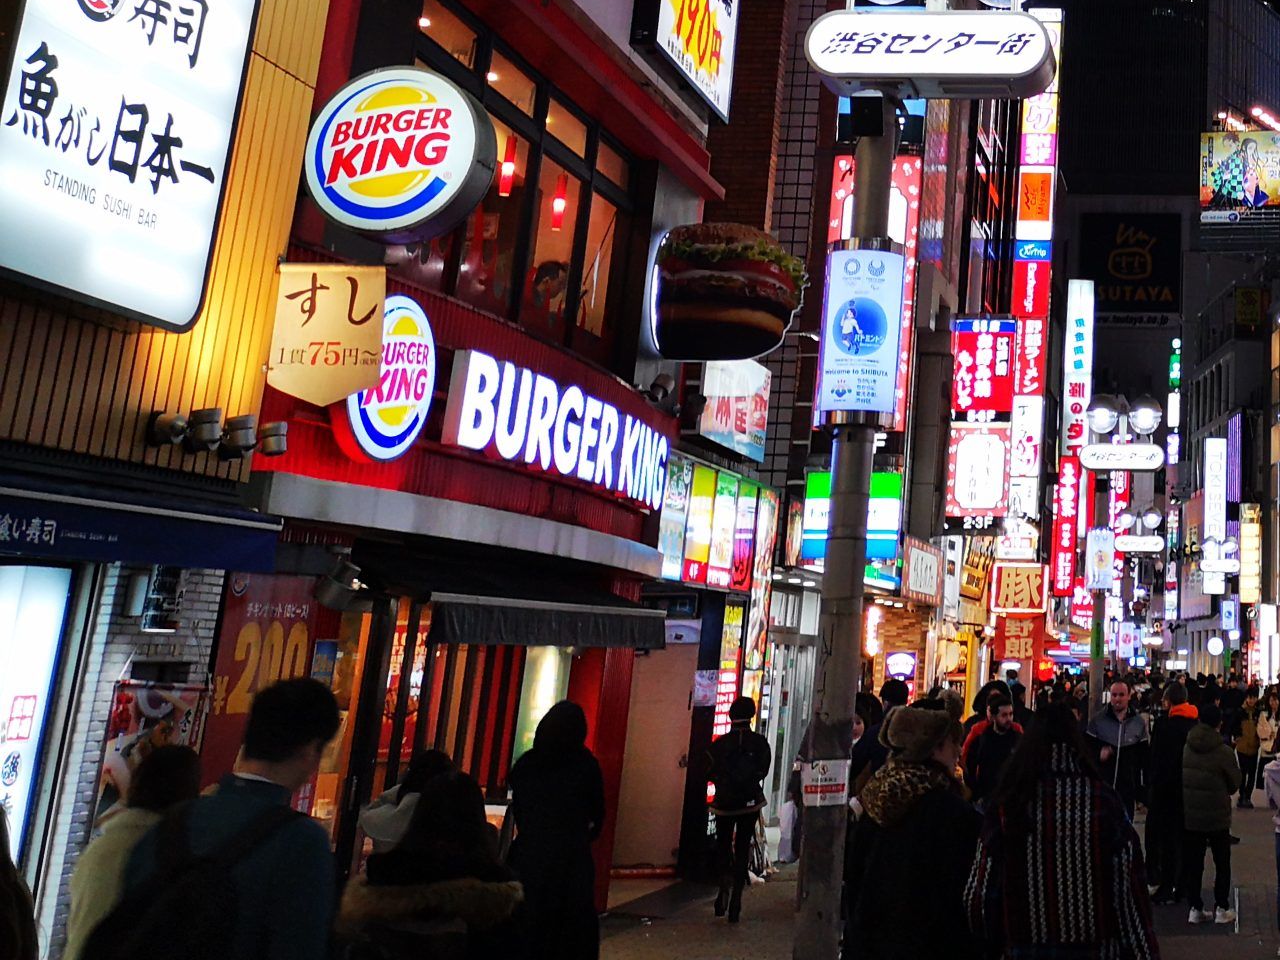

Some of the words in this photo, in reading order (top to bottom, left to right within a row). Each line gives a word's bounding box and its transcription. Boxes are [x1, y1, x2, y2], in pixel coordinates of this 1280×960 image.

[821, 30, 1037, 58] 渋谷センター街
[5, 41, 216, 195] 魚がし日本一
[330, 107, 452, 148] BURGER
[325, 134, 451, 186] KING
[44, 168, 96, 205] STANDING
[103, 194, 133, 221] SUSHI
[138, 208, 158, 230] BAR
[284, 272, 378, 328] すし
[1096, 285, 1175, 302] SUTAYA
[860, 368, 889, 377] SHIBUYA
[457, 350, 620, 488] BURGER
[618, 413, 669, 511] KING
[998, 567, 1042, 609] 豚
[1004, 618, 1034, 659] 野郎
